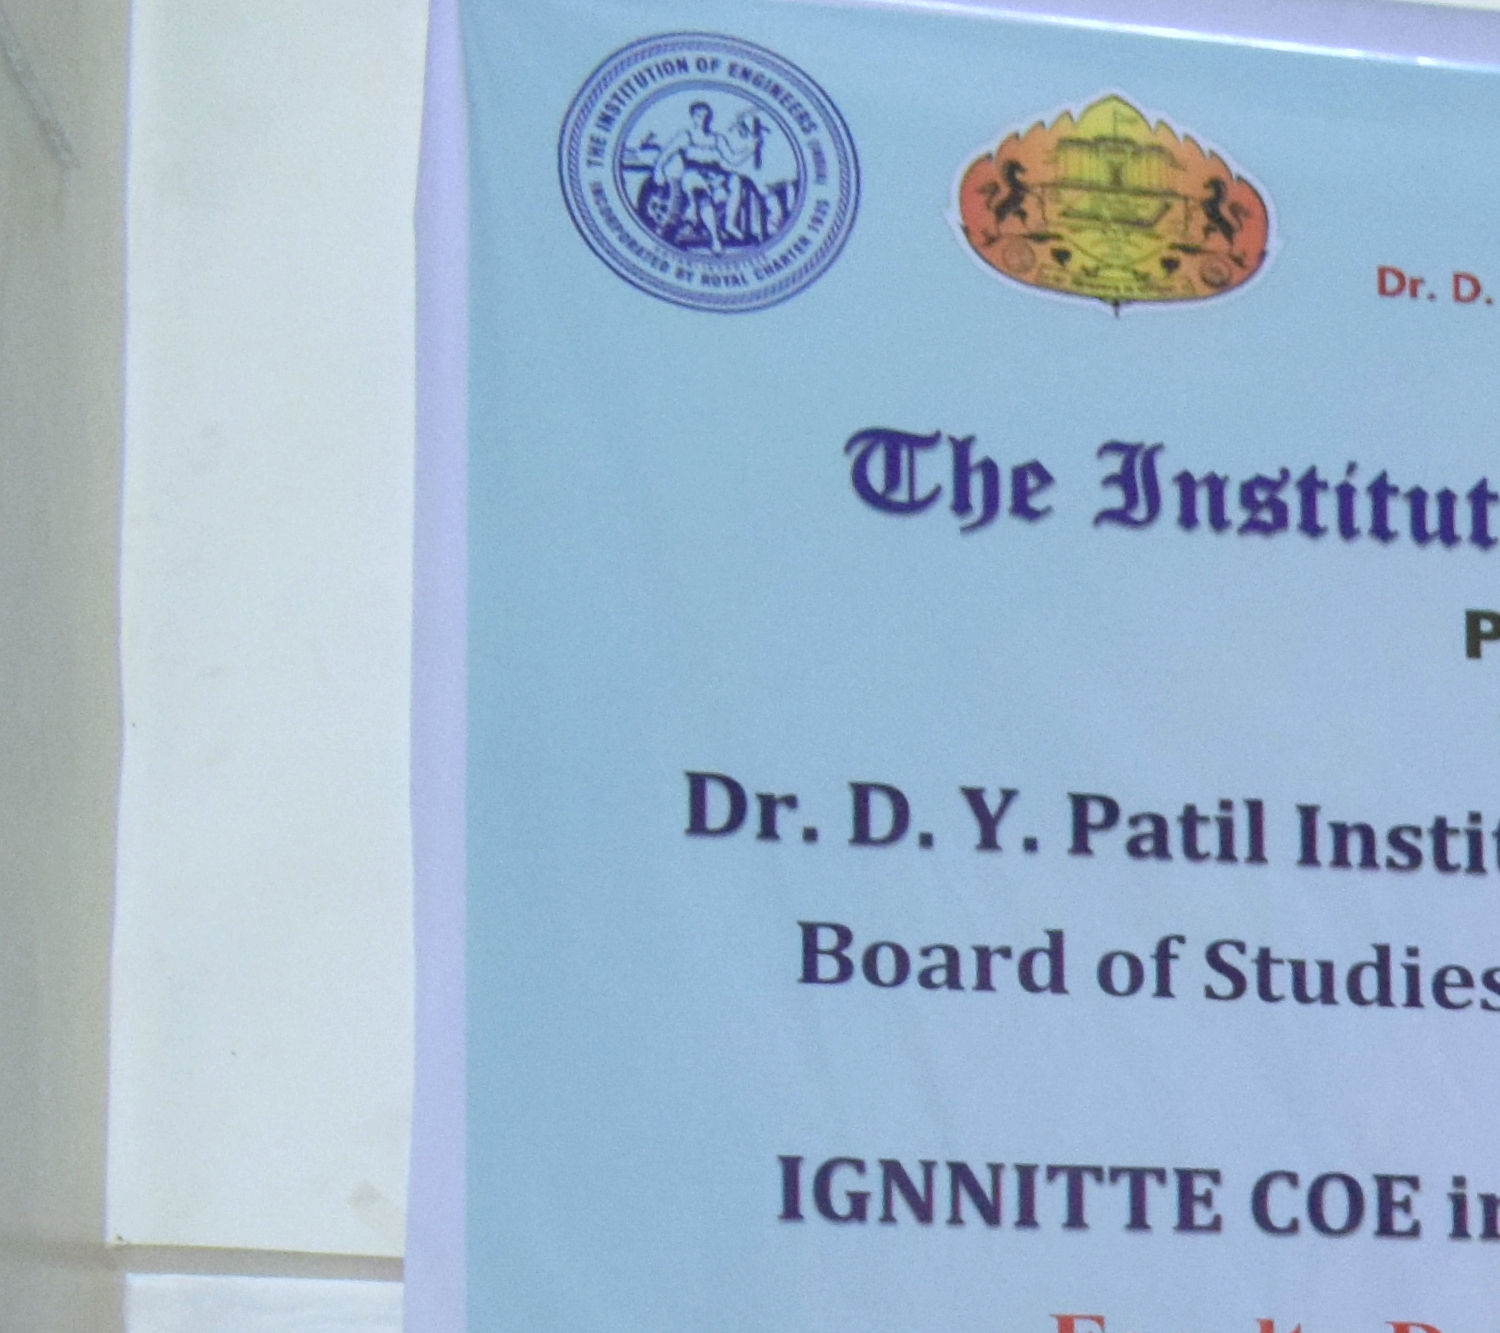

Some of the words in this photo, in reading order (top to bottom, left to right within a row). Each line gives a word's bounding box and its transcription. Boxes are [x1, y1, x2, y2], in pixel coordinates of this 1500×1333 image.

[586, 135, 606, 169] THE
[597, 57, 689, 132] INSTITUTION
[695, 57, 722, 74] OF
[728, 60, 818, 134] ENGINEERS
[1376, 266, 1436, 302] Dr.
[1451, 268, 1495, 306] D.
[843, 427, 1056, 534] The
[682, 771, 820, 842] Dr.
[848, 782, 936, 850] D.
[961, 786, 1040, 855] Y.
[1067, 792, 1267, 866] Patil
[795, 919, 1068, 998] Board
[1097, 934, 1185, 1000] of
[775, 1154, 1222, 1233] IGNNITTE
[1251, 1167, 1425, 1240] COE
